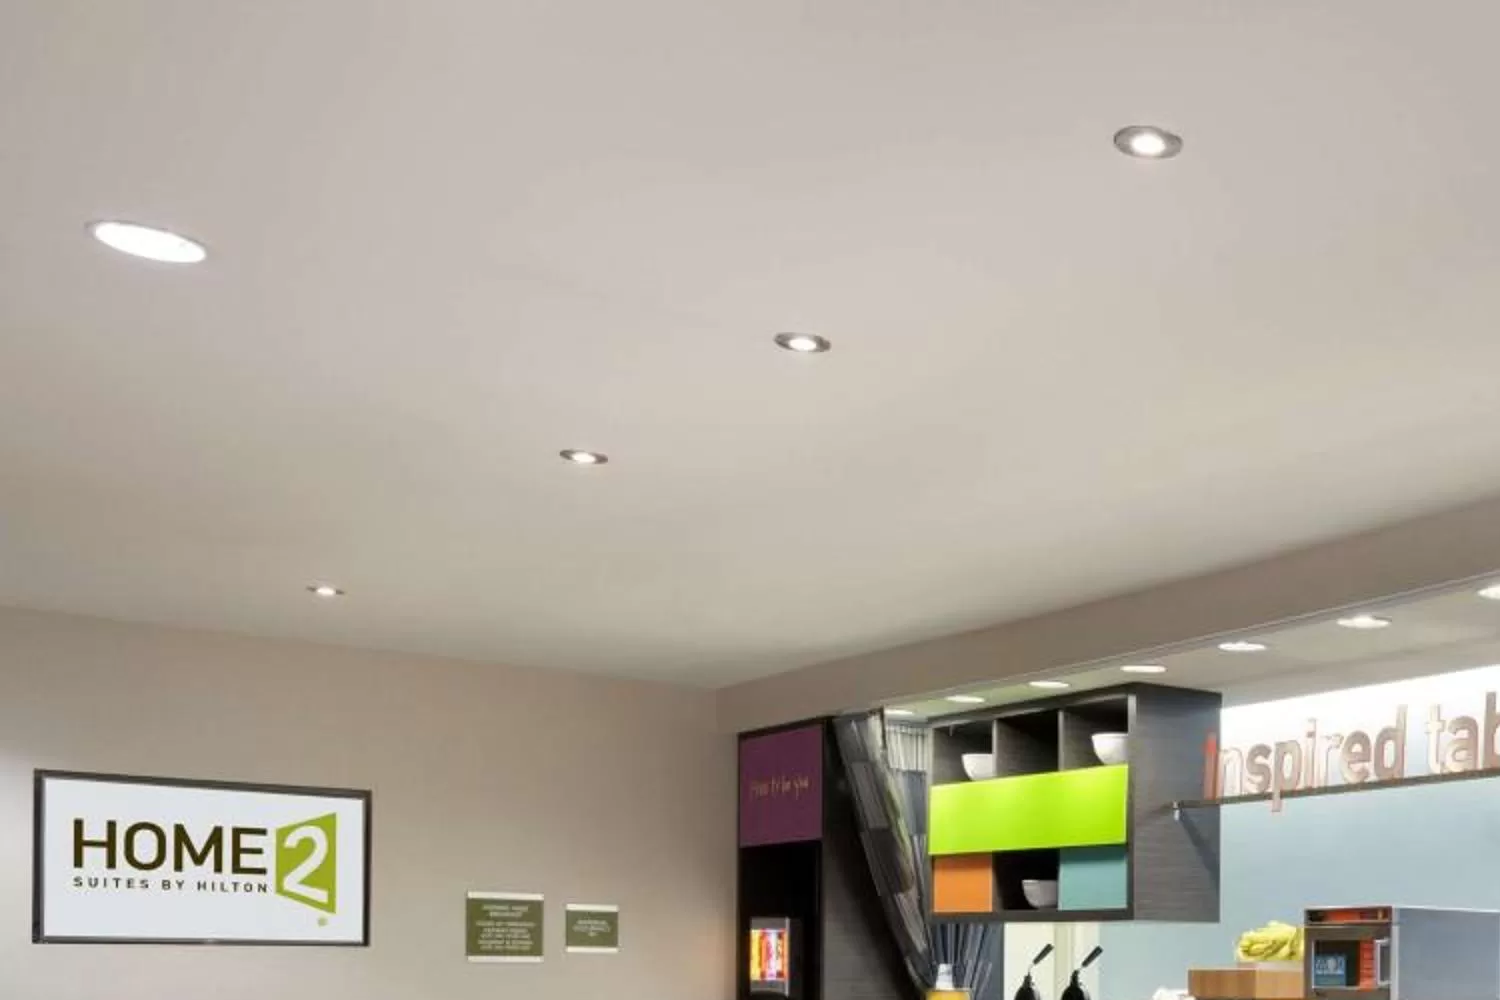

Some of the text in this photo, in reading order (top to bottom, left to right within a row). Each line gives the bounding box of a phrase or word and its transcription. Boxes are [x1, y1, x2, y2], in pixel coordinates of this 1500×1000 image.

[73, 818, 329, 904] HOME 2
[73, 876, 268, 893] SUITES BY HILTON
